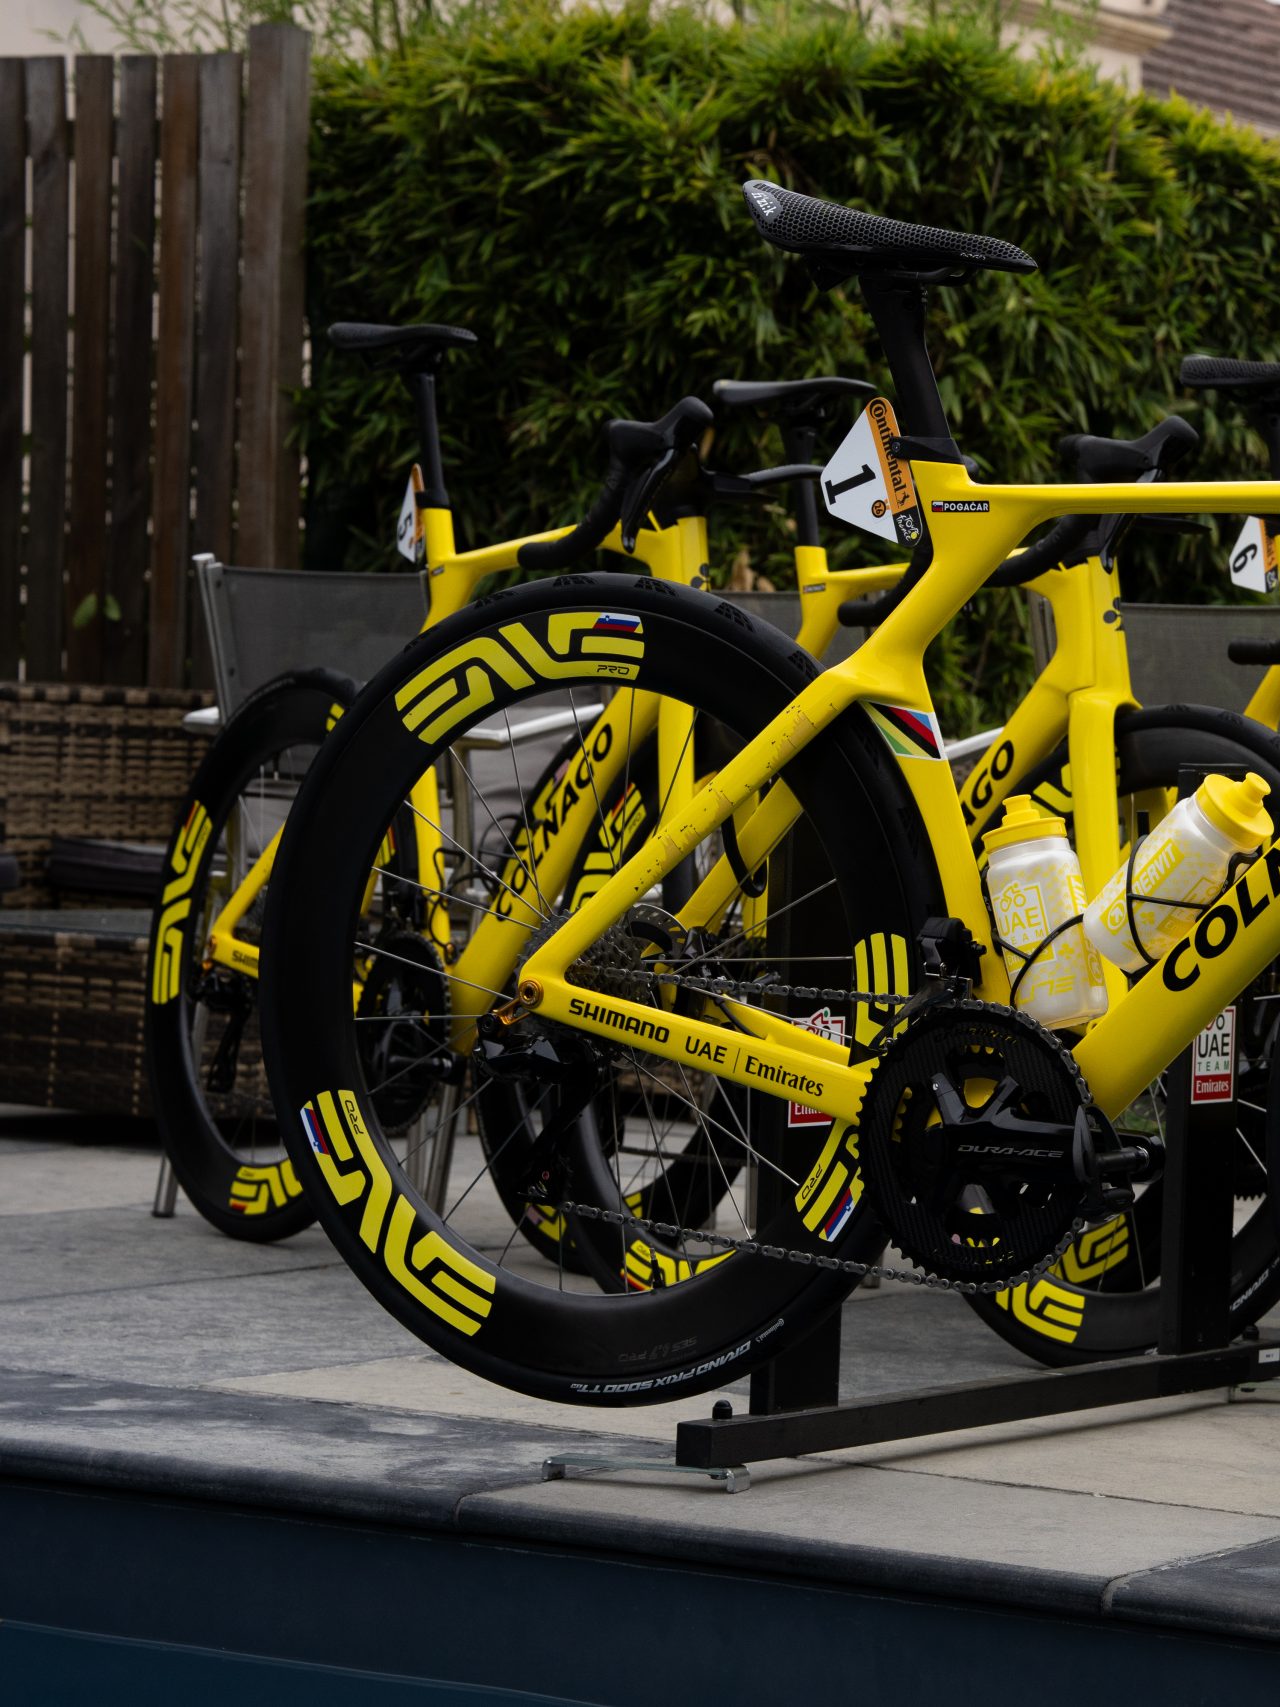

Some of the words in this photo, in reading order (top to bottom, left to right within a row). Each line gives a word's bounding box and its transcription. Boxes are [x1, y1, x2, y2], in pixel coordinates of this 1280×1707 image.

[825, 463, 876, 505] 1
[944, 501, 989, 511] POGAČAR
[1233, 544, 1257, 573] 6
[597, 664, 630, 676] PRO
[1000, 906, 1041, 937] UAE
[569, 998, 670, 1043] SHIMANO
[1198, 1032, 1231, 1058] UAE
[685, 1035, 728, 1064] UAE
[744, 1054, 824, 1097] Emirates
[1197, 1060, 1230, 1072] TEAM
[1196, 1079, 1230, 1094] Emirates
[958, 1143, 1065, 1158] DURA-ACE
[696, 1340, 751, 1376] GRAND
[603, 1380, 653, 1394] 5000
[653, 1368, 696, 1388] PRIX
